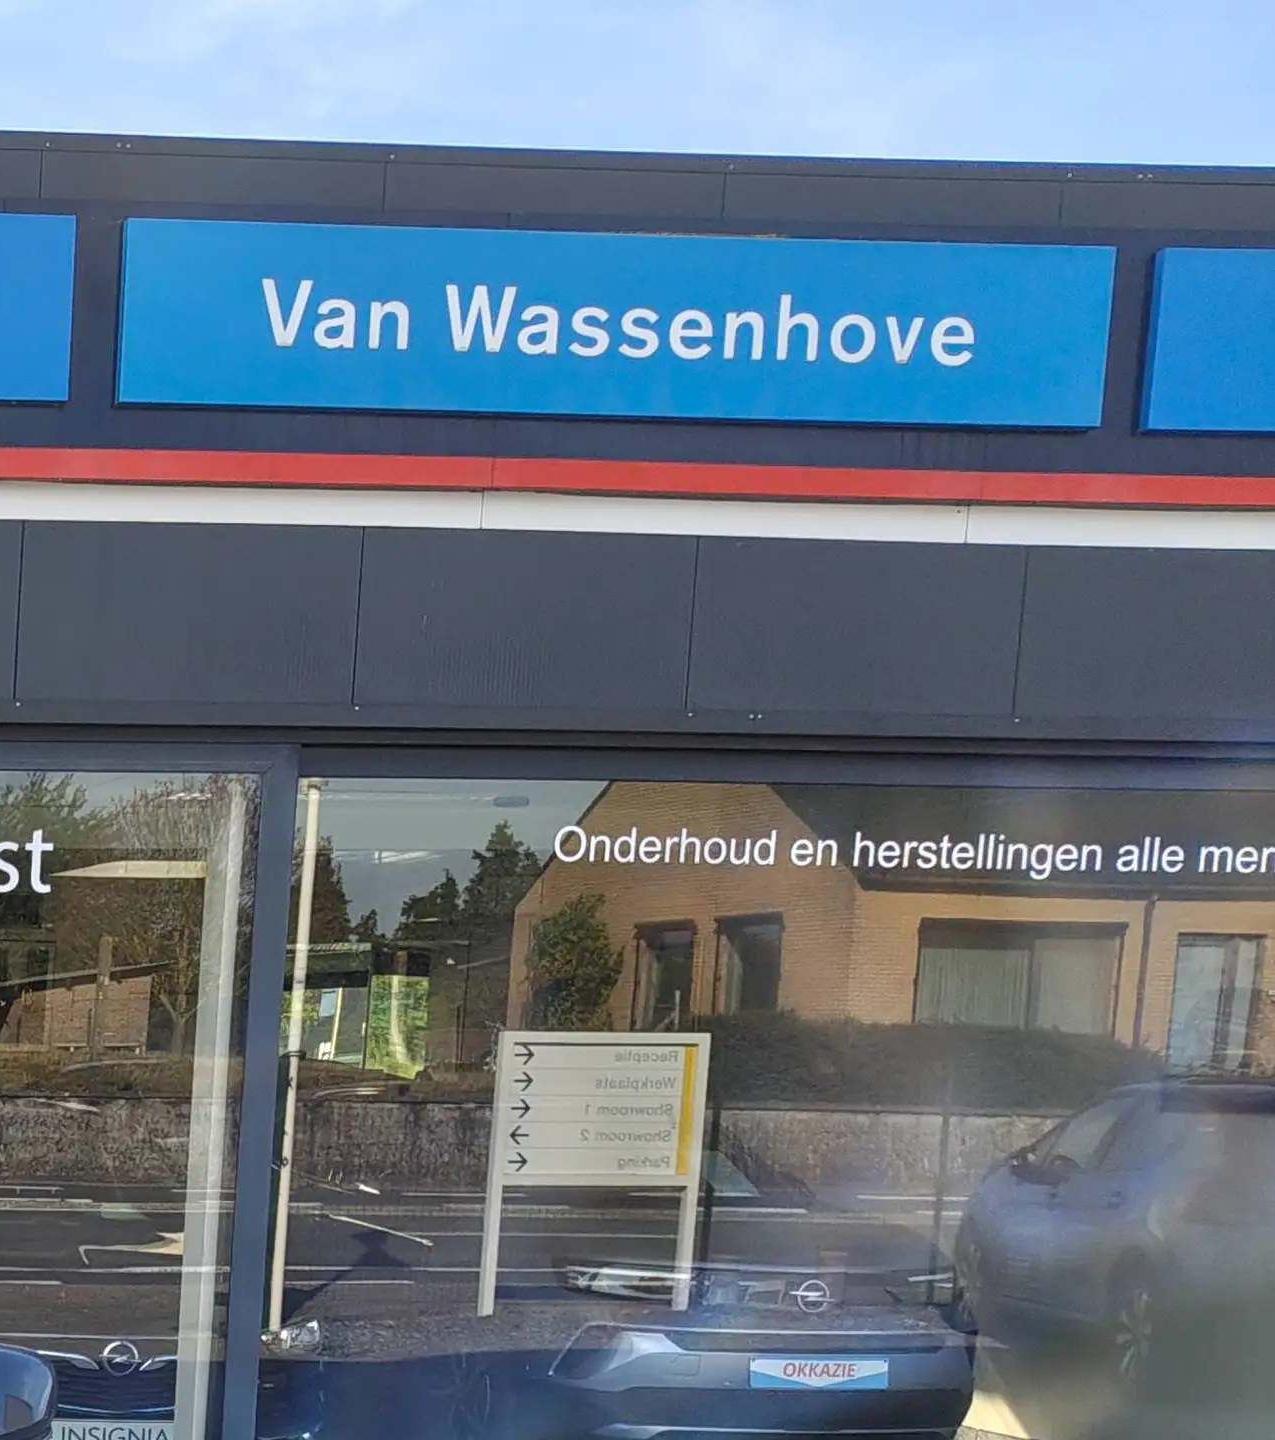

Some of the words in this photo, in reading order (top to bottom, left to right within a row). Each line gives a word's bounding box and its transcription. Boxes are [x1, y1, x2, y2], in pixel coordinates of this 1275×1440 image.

[262, 278, 410, 350] Van
[446, 284, 976, 366] Wassenhove
[553, 824, 778, 867] Onderhoud
[790, 838, 839, 867] en
[852, 830, 1103, 881] herstellingen
[1115, 835, 1185, 874] alle
[782, 1362, 857, 1378] OKKAZIE
